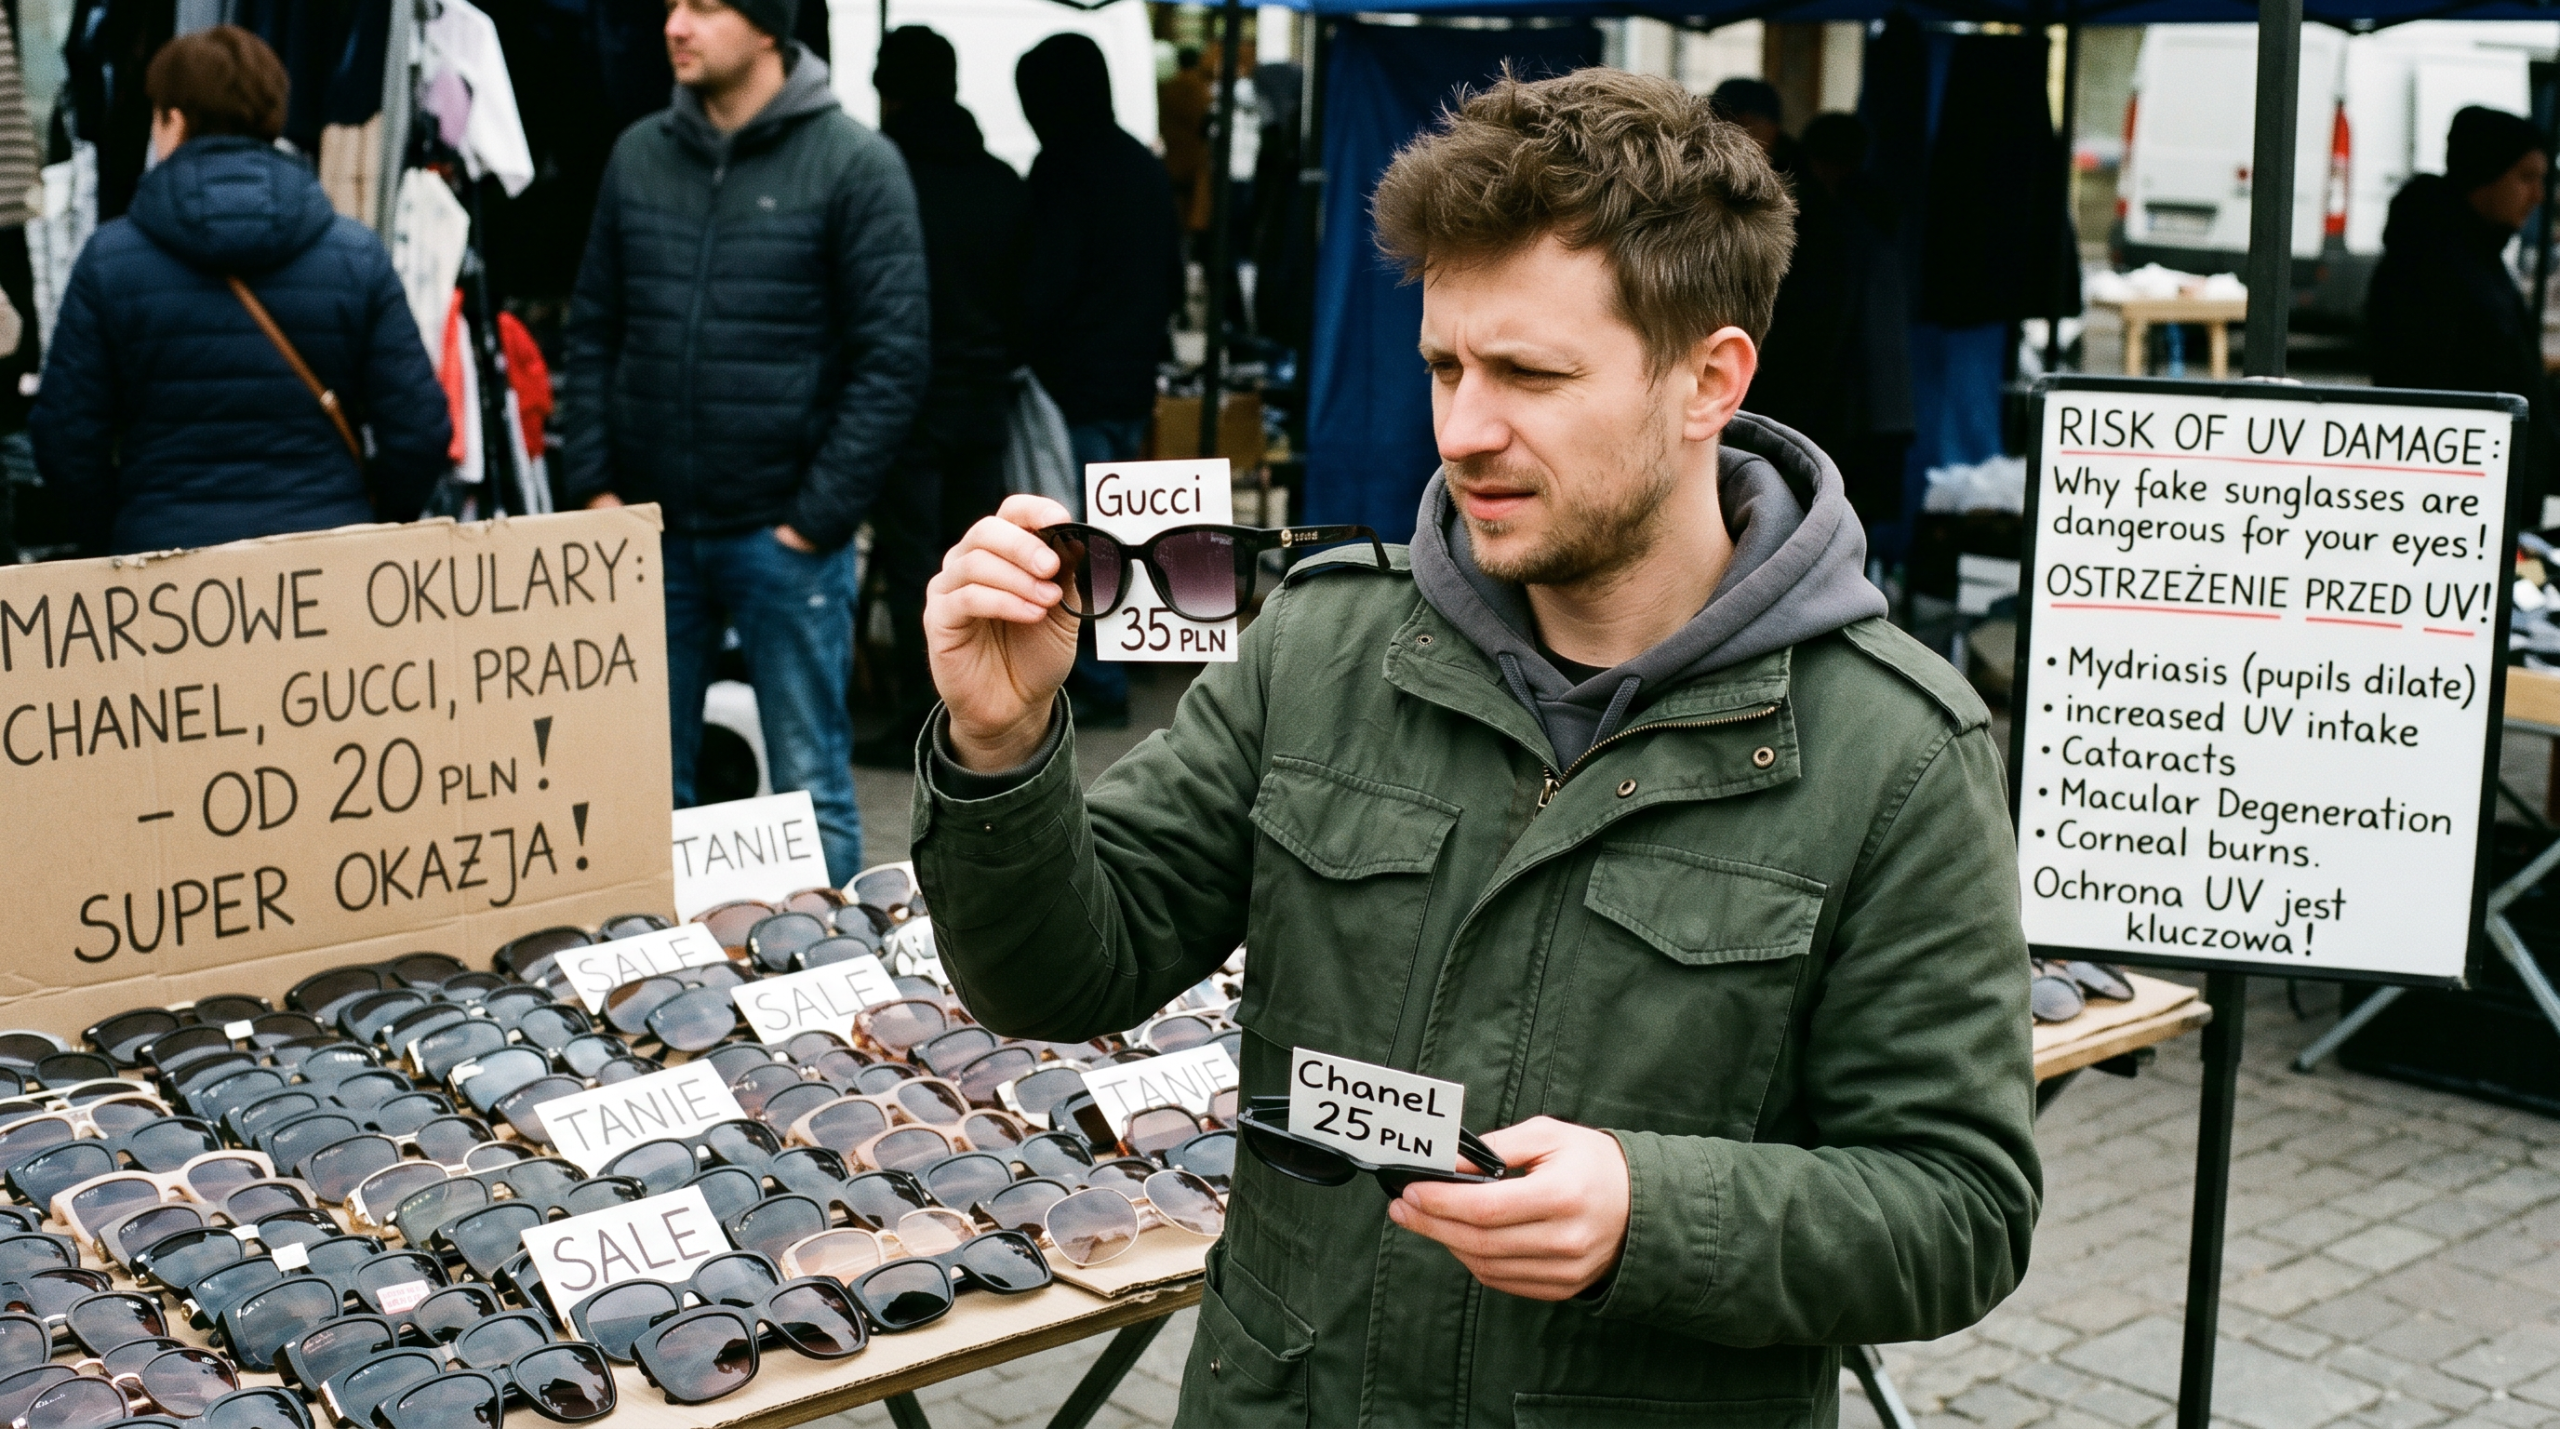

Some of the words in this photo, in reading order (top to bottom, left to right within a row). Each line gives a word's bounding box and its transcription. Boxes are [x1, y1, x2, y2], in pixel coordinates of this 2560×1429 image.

[2060, 406, 2155, 449] RISK
[2175, 413, 2228, 452] OF
[2247, 417, 2306, 456] UV
[2323, 420, 2501, 466] DAMAGE:
[1095, 473, 1201, 517] Gucci
[2053, 465, 2121, 509] Why
[2135, 467, 2208, 508] fake
[2225, 475, 2406, 520] sunglasses
[2422, 492, 2480, 517] are
[2052, 505, 2226, 553] dangerous
[2242, 514, 2291, 554] for
[2304, 528, 2379, 560] your
[2392, 523, 2488, 567] eyes!
[0, 568, 328, 672] MARSOWE
[366, 538, 645, 629] OKULARY:
[2046, 563, 2289, 609] OSTRZEŻENIE
[2306, 578, 2412, 616] PRZED
[2425, 582, 2493, 624] UV!
[1120, 606, 1173, 652] 35
[1180, 628, 1227, 652] PLN
[2, 682, 265, 767] CHANEL,
[281, 659, 456, 728] GUCCI,
[473, 633, 638, 704] PRADA
[2069, 646, 2228, 691] Mydriasis
[2243, 651, 2352, 700] (pupils
[2364, 663, 2477, 710] dilate)
[2066, 694, 2225, 733] increased
[2244, 705, 2294, 737] UV
[2308, 710, 2420, 748] intake
[2062, 736, 2236, 777] Cataracts
[202, 766, 298, 838] OD
[329, 737, 423, 824] 20
[2061, 777, 2200, 817] Macular
[2218, 787, 2452, 836] Degeneration
[672, 819, 812, 878] TANIE
[2057, 819, 2187, 858] Corneal
[2208, 829, 2321, 868] burns.
[74, 865, 295, 965] SUPER
[2033, 866, 2184, 909] Ochrona
[2206, 875, 2264, 914] UV
[2275, 887, 2346, 928] jest
[2127, 911, 2315, 957] kluczowa!
[754, 969, 891, 1032] SALE
[552, 1077, 721, 1153] TANIE
[1312, 1100, 1374, 1142] 25
[1379, 1126, 1434, 1159] PLN
[552, 1206, 711, 1293] SALE
